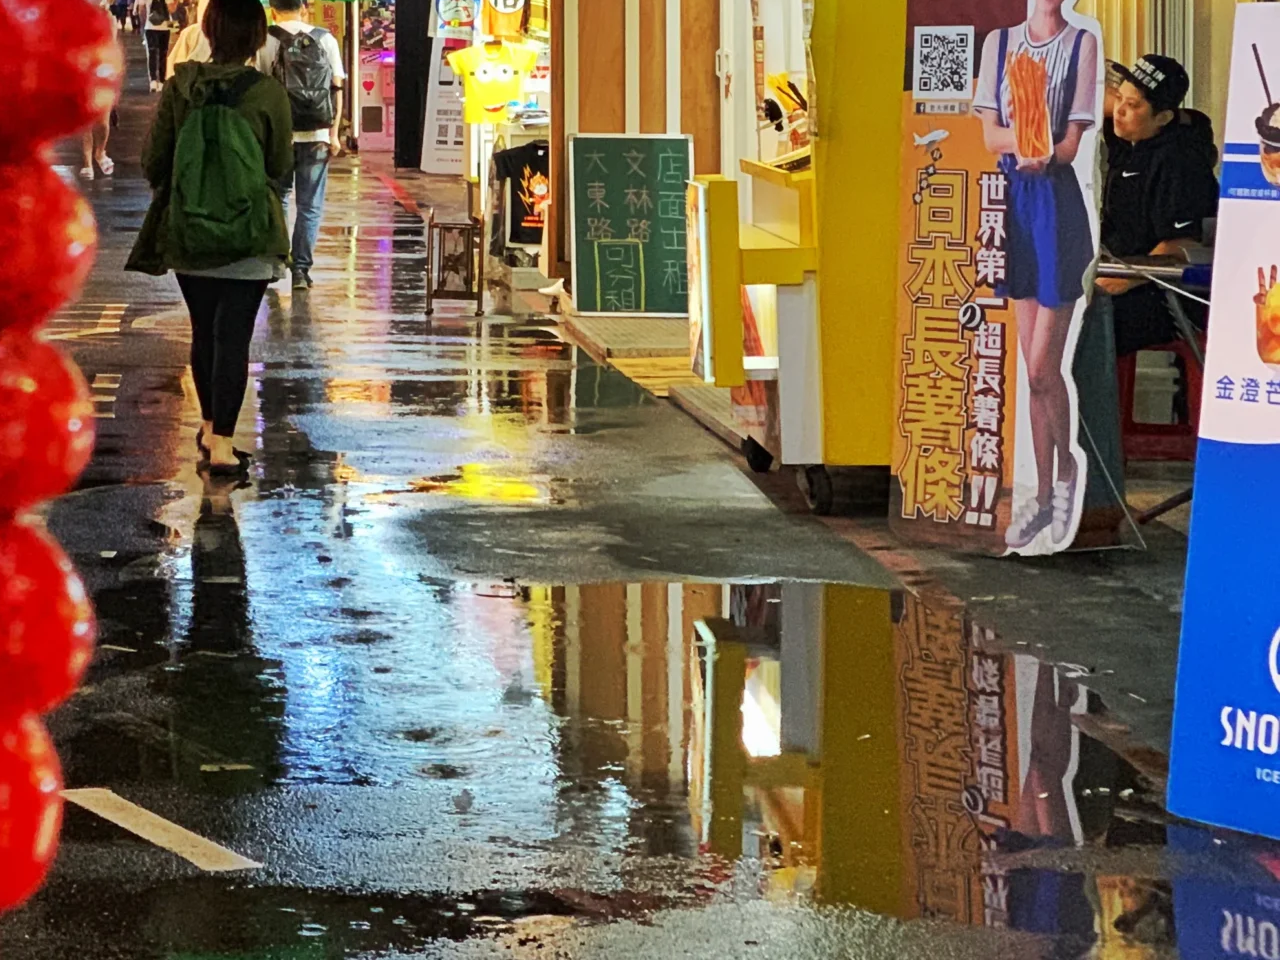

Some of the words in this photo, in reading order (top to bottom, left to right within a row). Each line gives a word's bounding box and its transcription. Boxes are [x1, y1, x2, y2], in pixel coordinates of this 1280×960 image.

[584, 149, 616, 241] 大東路
[623, 148, 654, 243] 文林路
[898, 170, 974, 524] 日本長薯條
